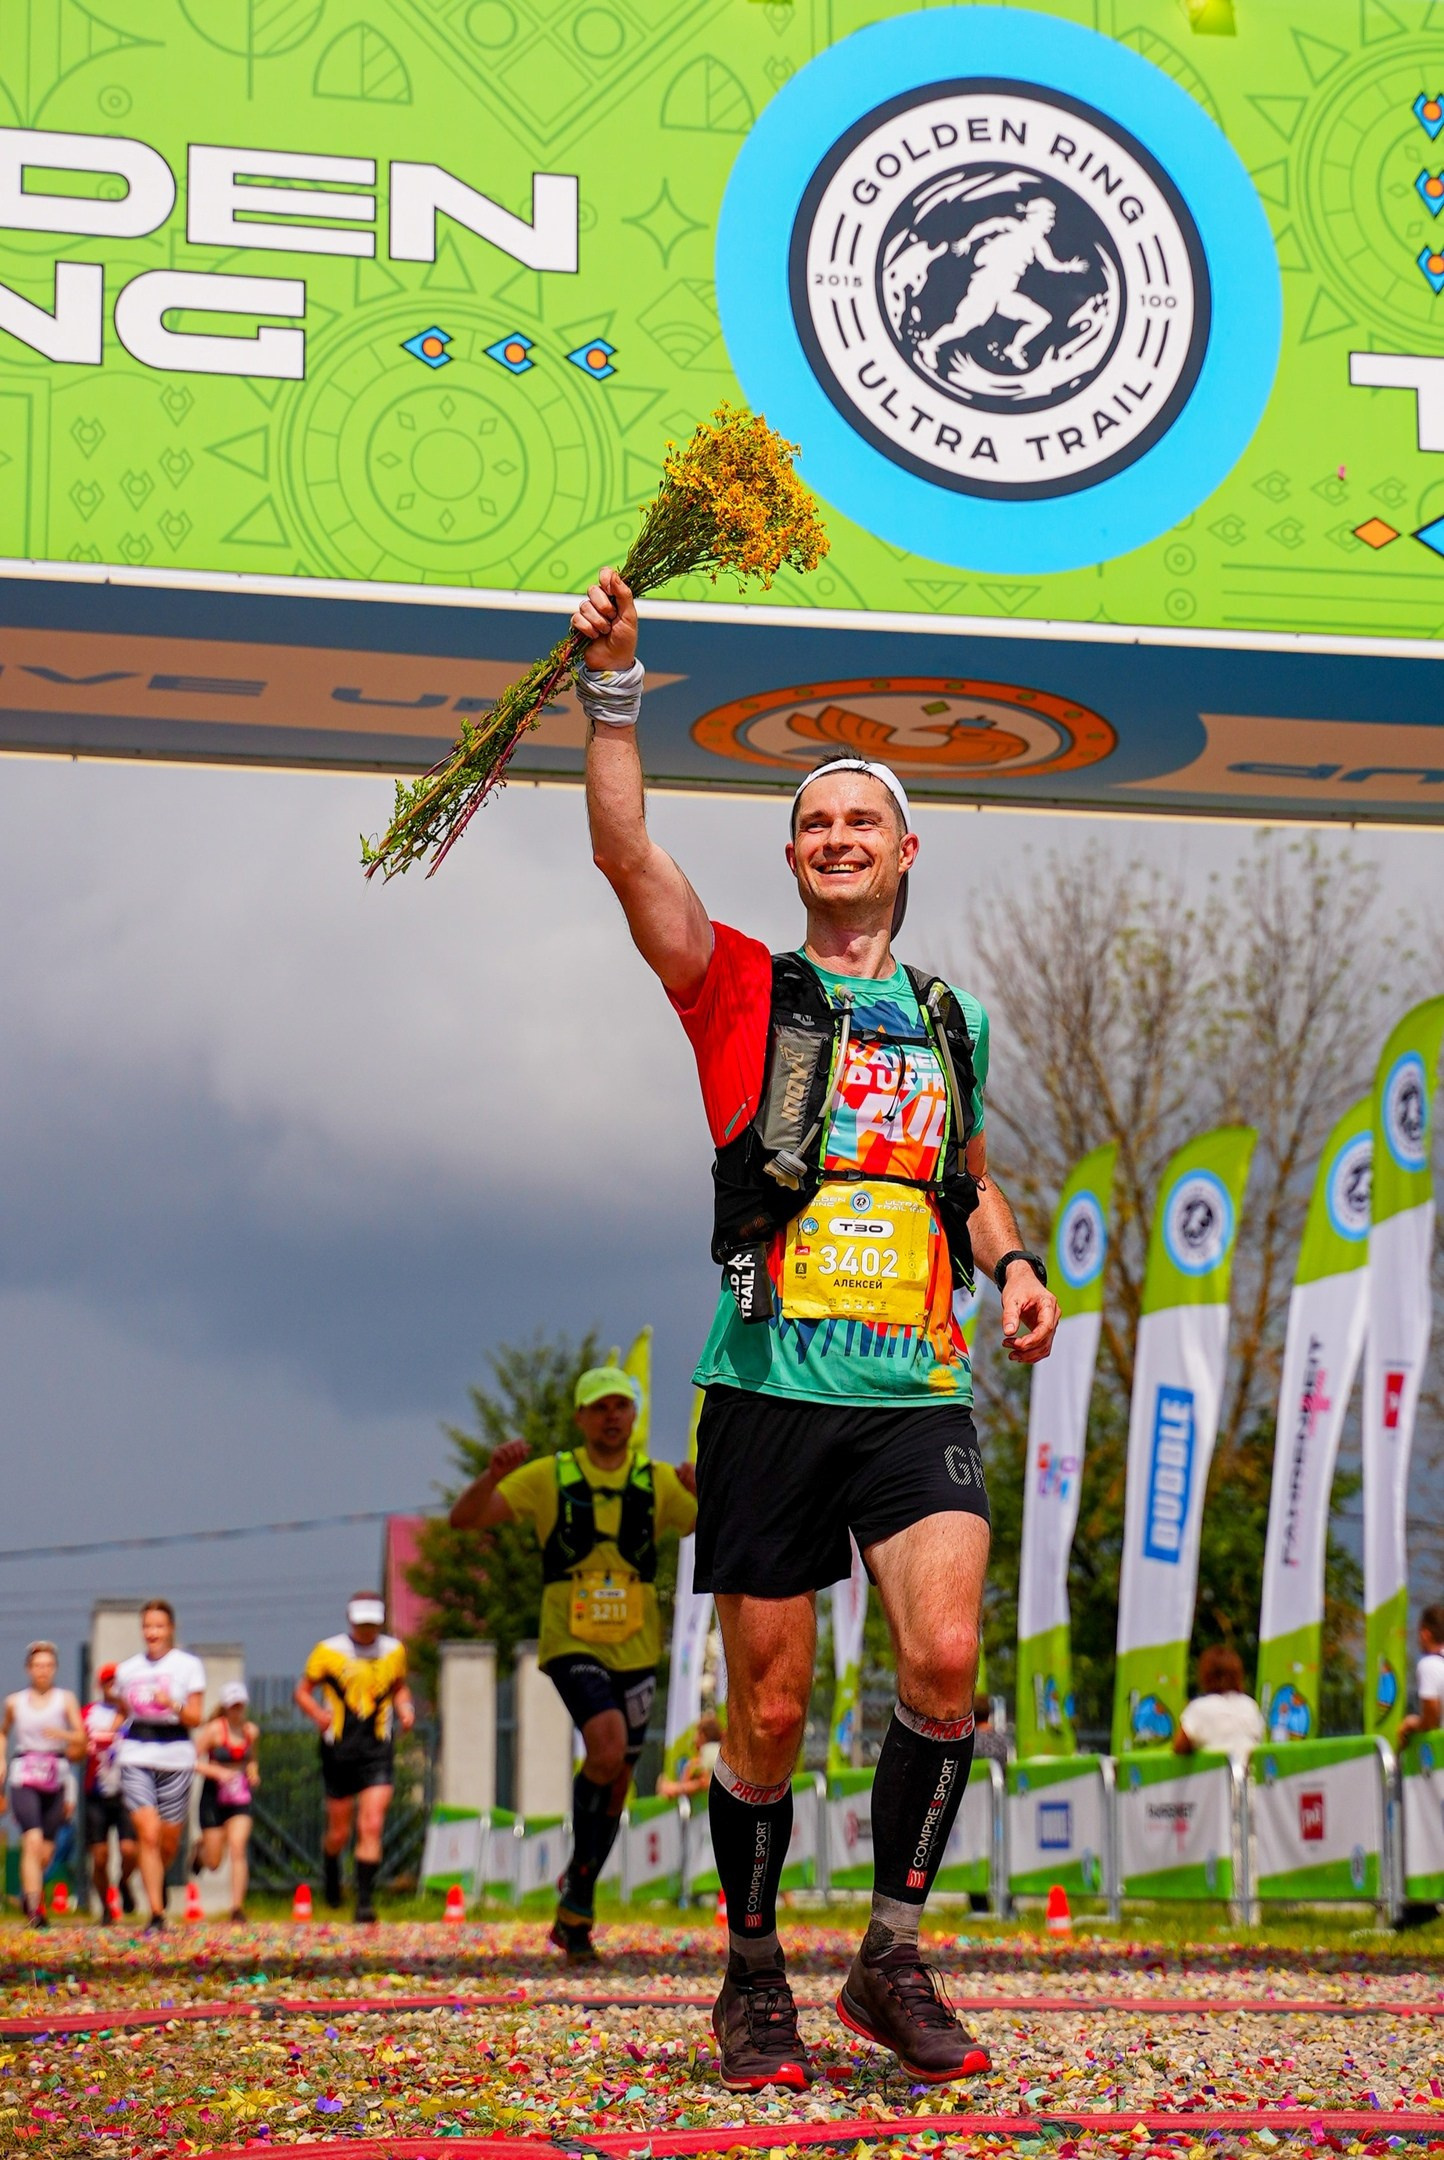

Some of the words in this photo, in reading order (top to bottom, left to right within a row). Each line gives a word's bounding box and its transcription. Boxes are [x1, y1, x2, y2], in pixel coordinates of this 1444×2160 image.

[852, 117, 1028, 206] GOLDEN
[1049, 133, 1145, 225] RING
[0, 126, 579, 274] DEN
[814, 273, 863, 288] 2015
[1140, 293, 1178, 309] 100
[857, 359, 999, 463] ULTRA
[1024, 381, 1153, 462] TRAIL
[0, 664, 268, 697] VE
[839, 1222, 884, 1234] T30
[818, 1244, 899, 1278] 3402
[741, 1269, 756, 1319] TRAIL
[833, 1278, 883, 1290] АЛЕКСЕЙ
[913, 1757, 955, 1869] COMPRESSPORT
[747, 1820, 768, 1913] COMPRESSPORT
